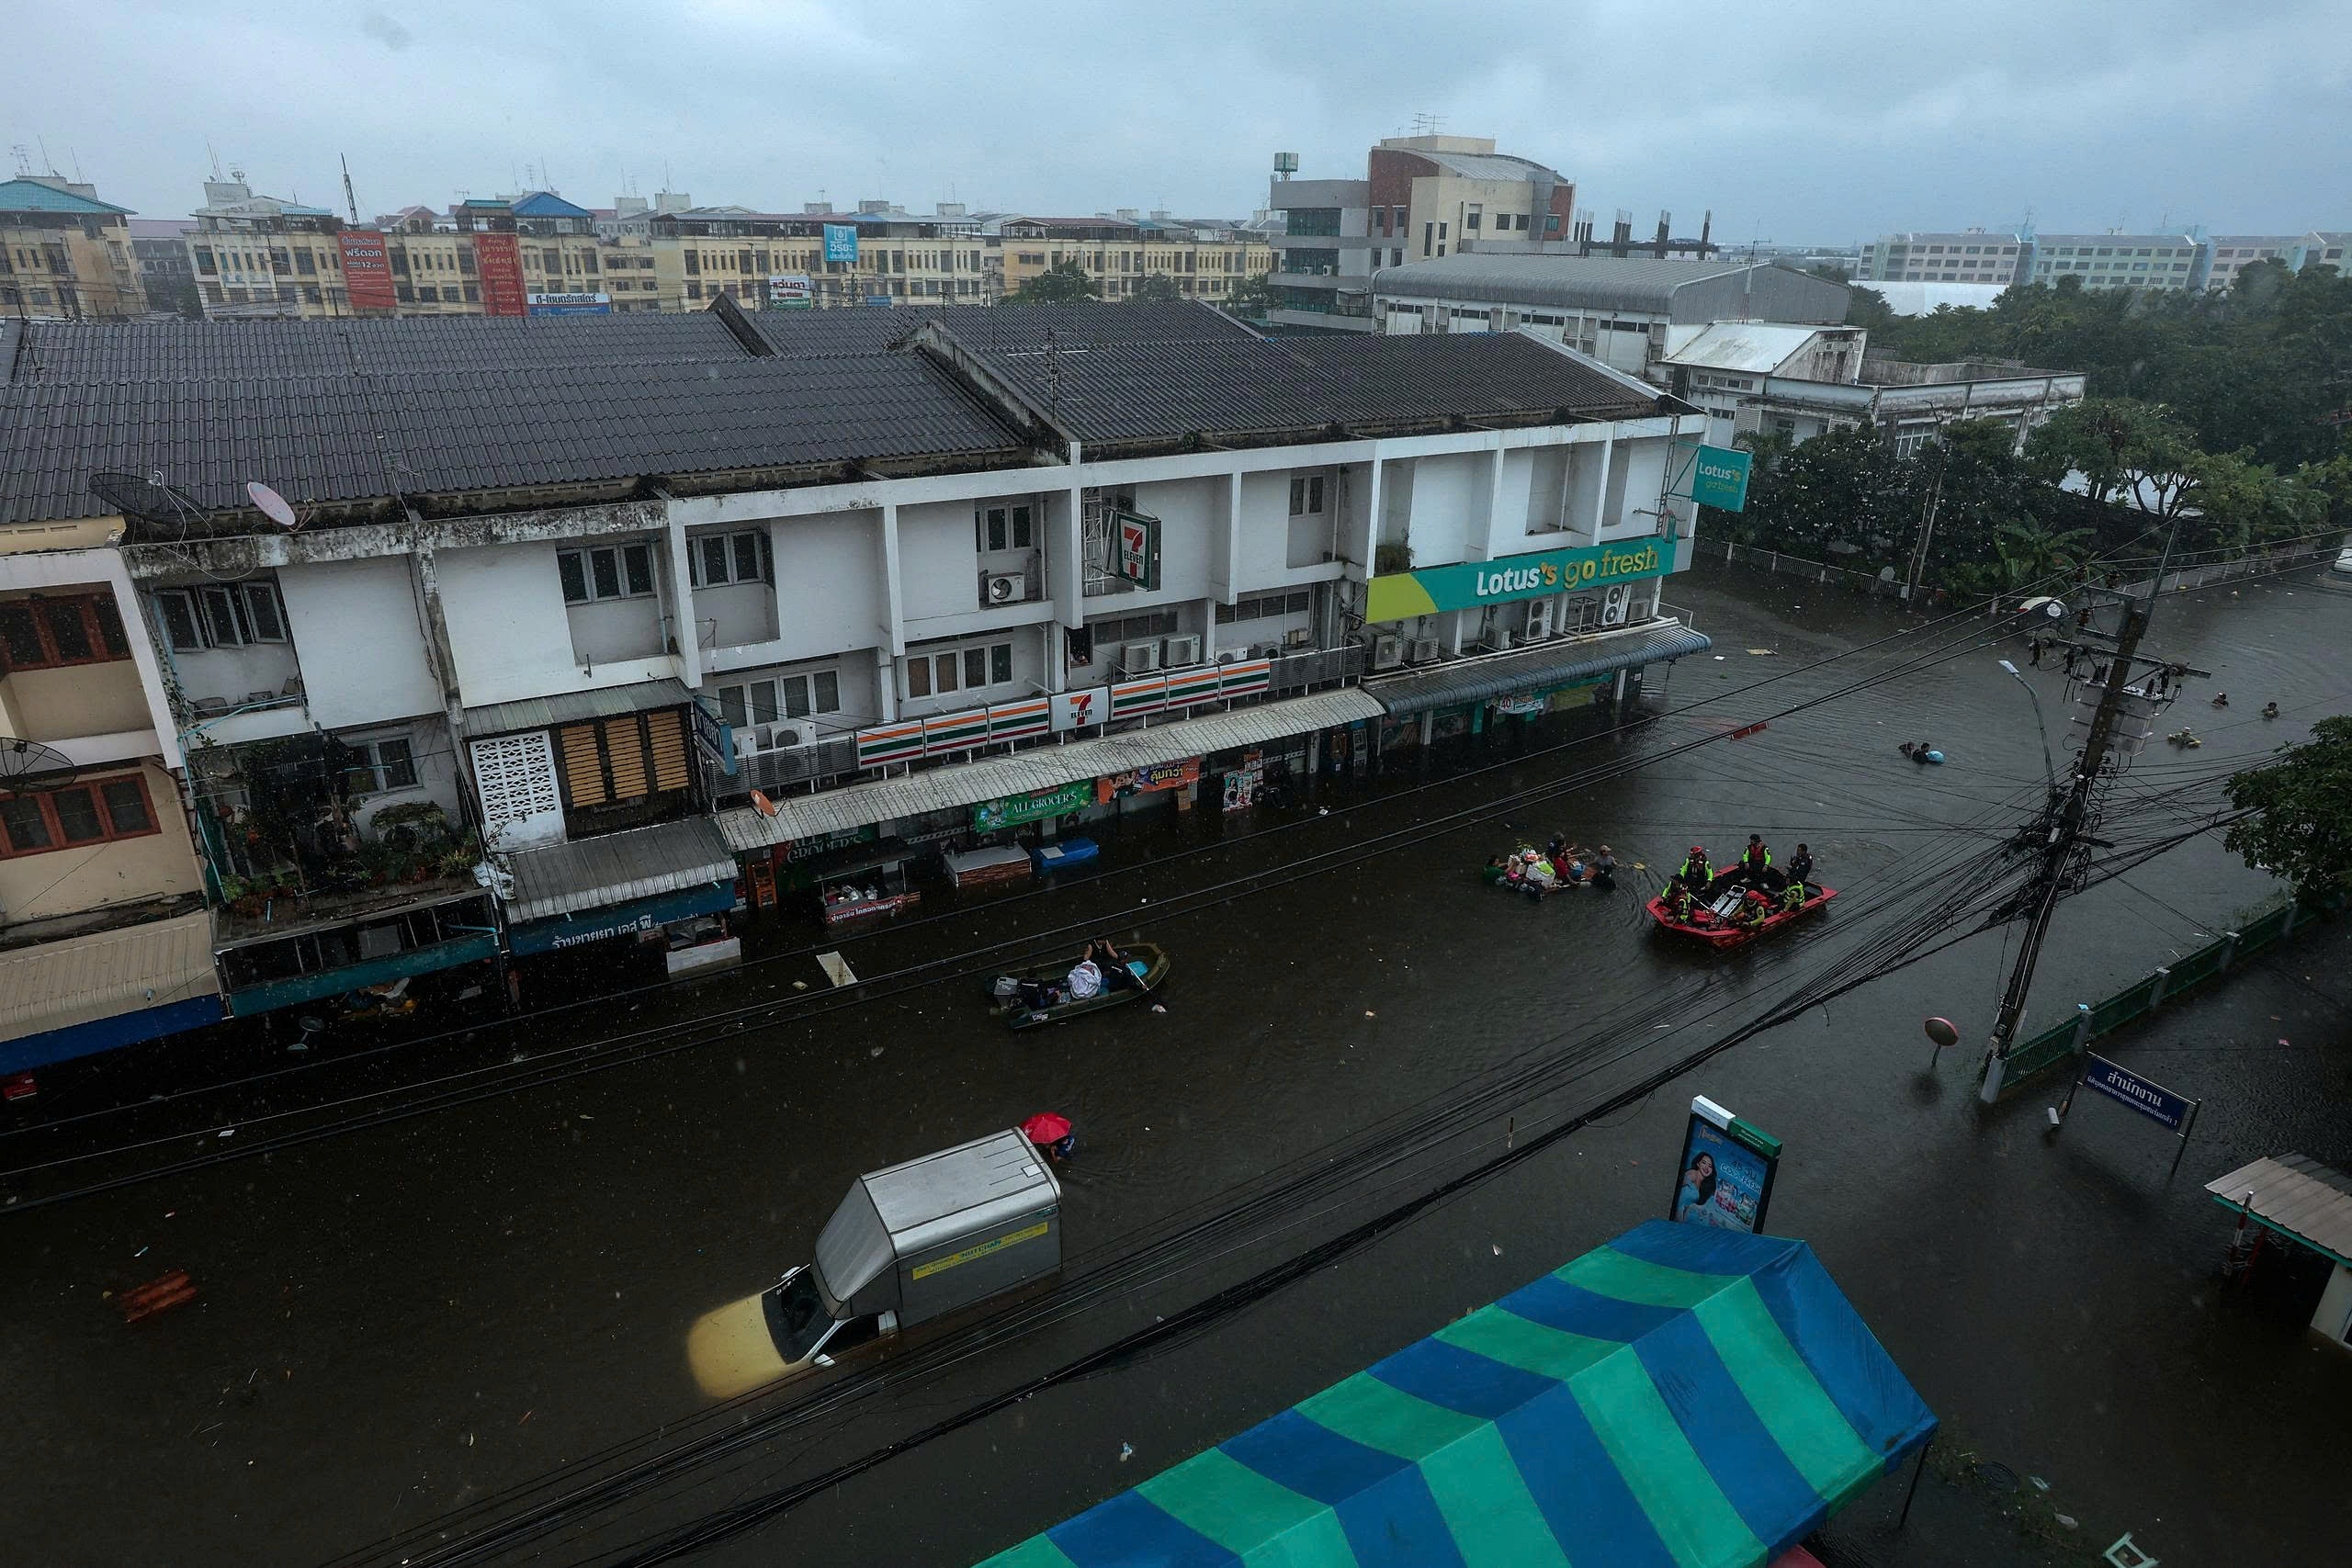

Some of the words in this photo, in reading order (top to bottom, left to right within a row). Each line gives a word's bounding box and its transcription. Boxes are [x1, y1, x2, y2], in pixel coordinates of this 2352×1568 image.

[1699, 462, 1742, 482] Lotus's
[1476, 562, 1558, 596] Lotus's
[1564, 559, 1597, 590] go
[1600, 545, 1659, 579] fresh
[1149, 765, 1183, 785] คุ้มกว่า
[1012, 802, 1030, 814] ALL
[1030, 792, 1077, 810] GROCER'S
[552, 928, 614, 948] ร้านขายยา
[618, 920, 638, 936] เอส
[2107, 1071, 2162, 1106] สำนักงาน
